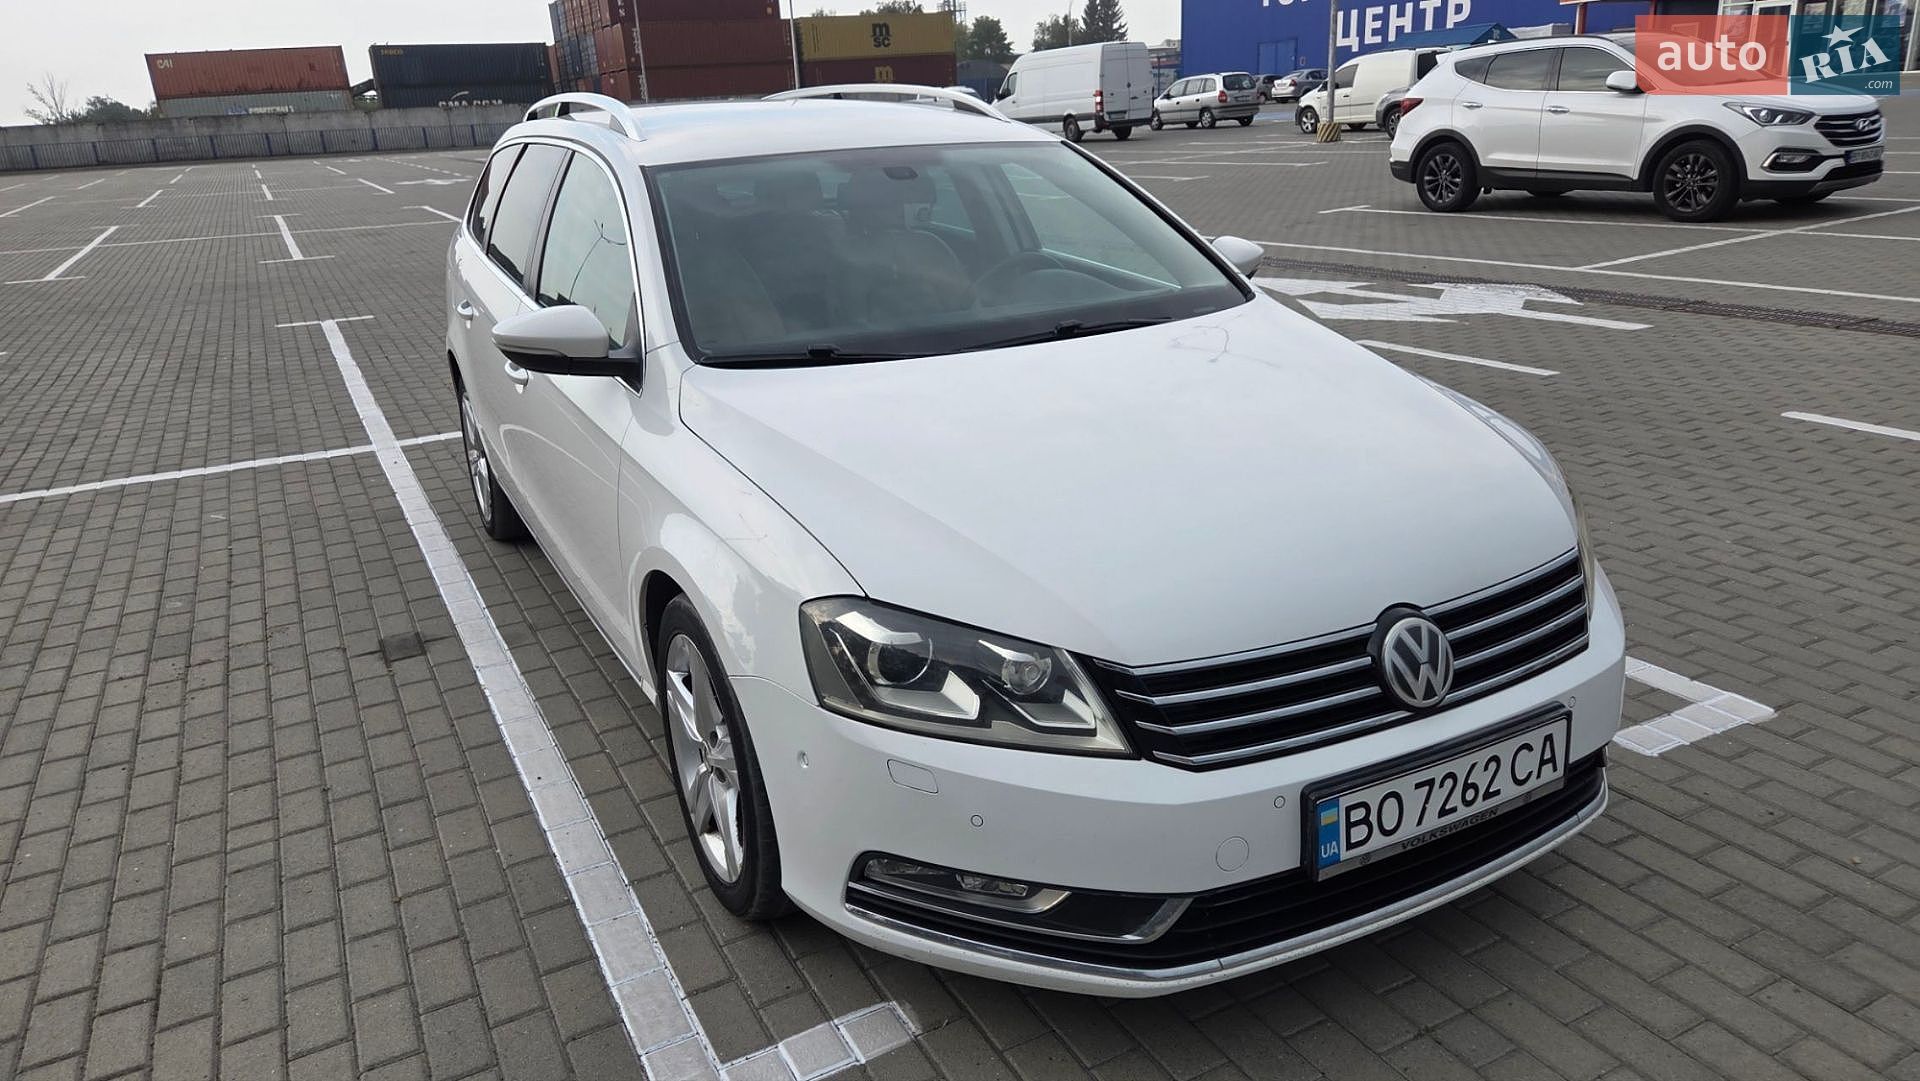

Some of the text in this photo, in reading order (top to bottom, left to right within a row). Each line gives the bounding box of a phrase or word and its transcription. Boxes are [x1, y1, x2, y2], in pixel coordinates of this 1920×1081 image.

[1336, 0, 1472, 52] ЦЕНТР
[1345, 732, 1558, 851] BO 7262 CA
[1320, 843, 1339, 858] UA
[1400, 808, 1499, 850] VOLKSWAGEN
